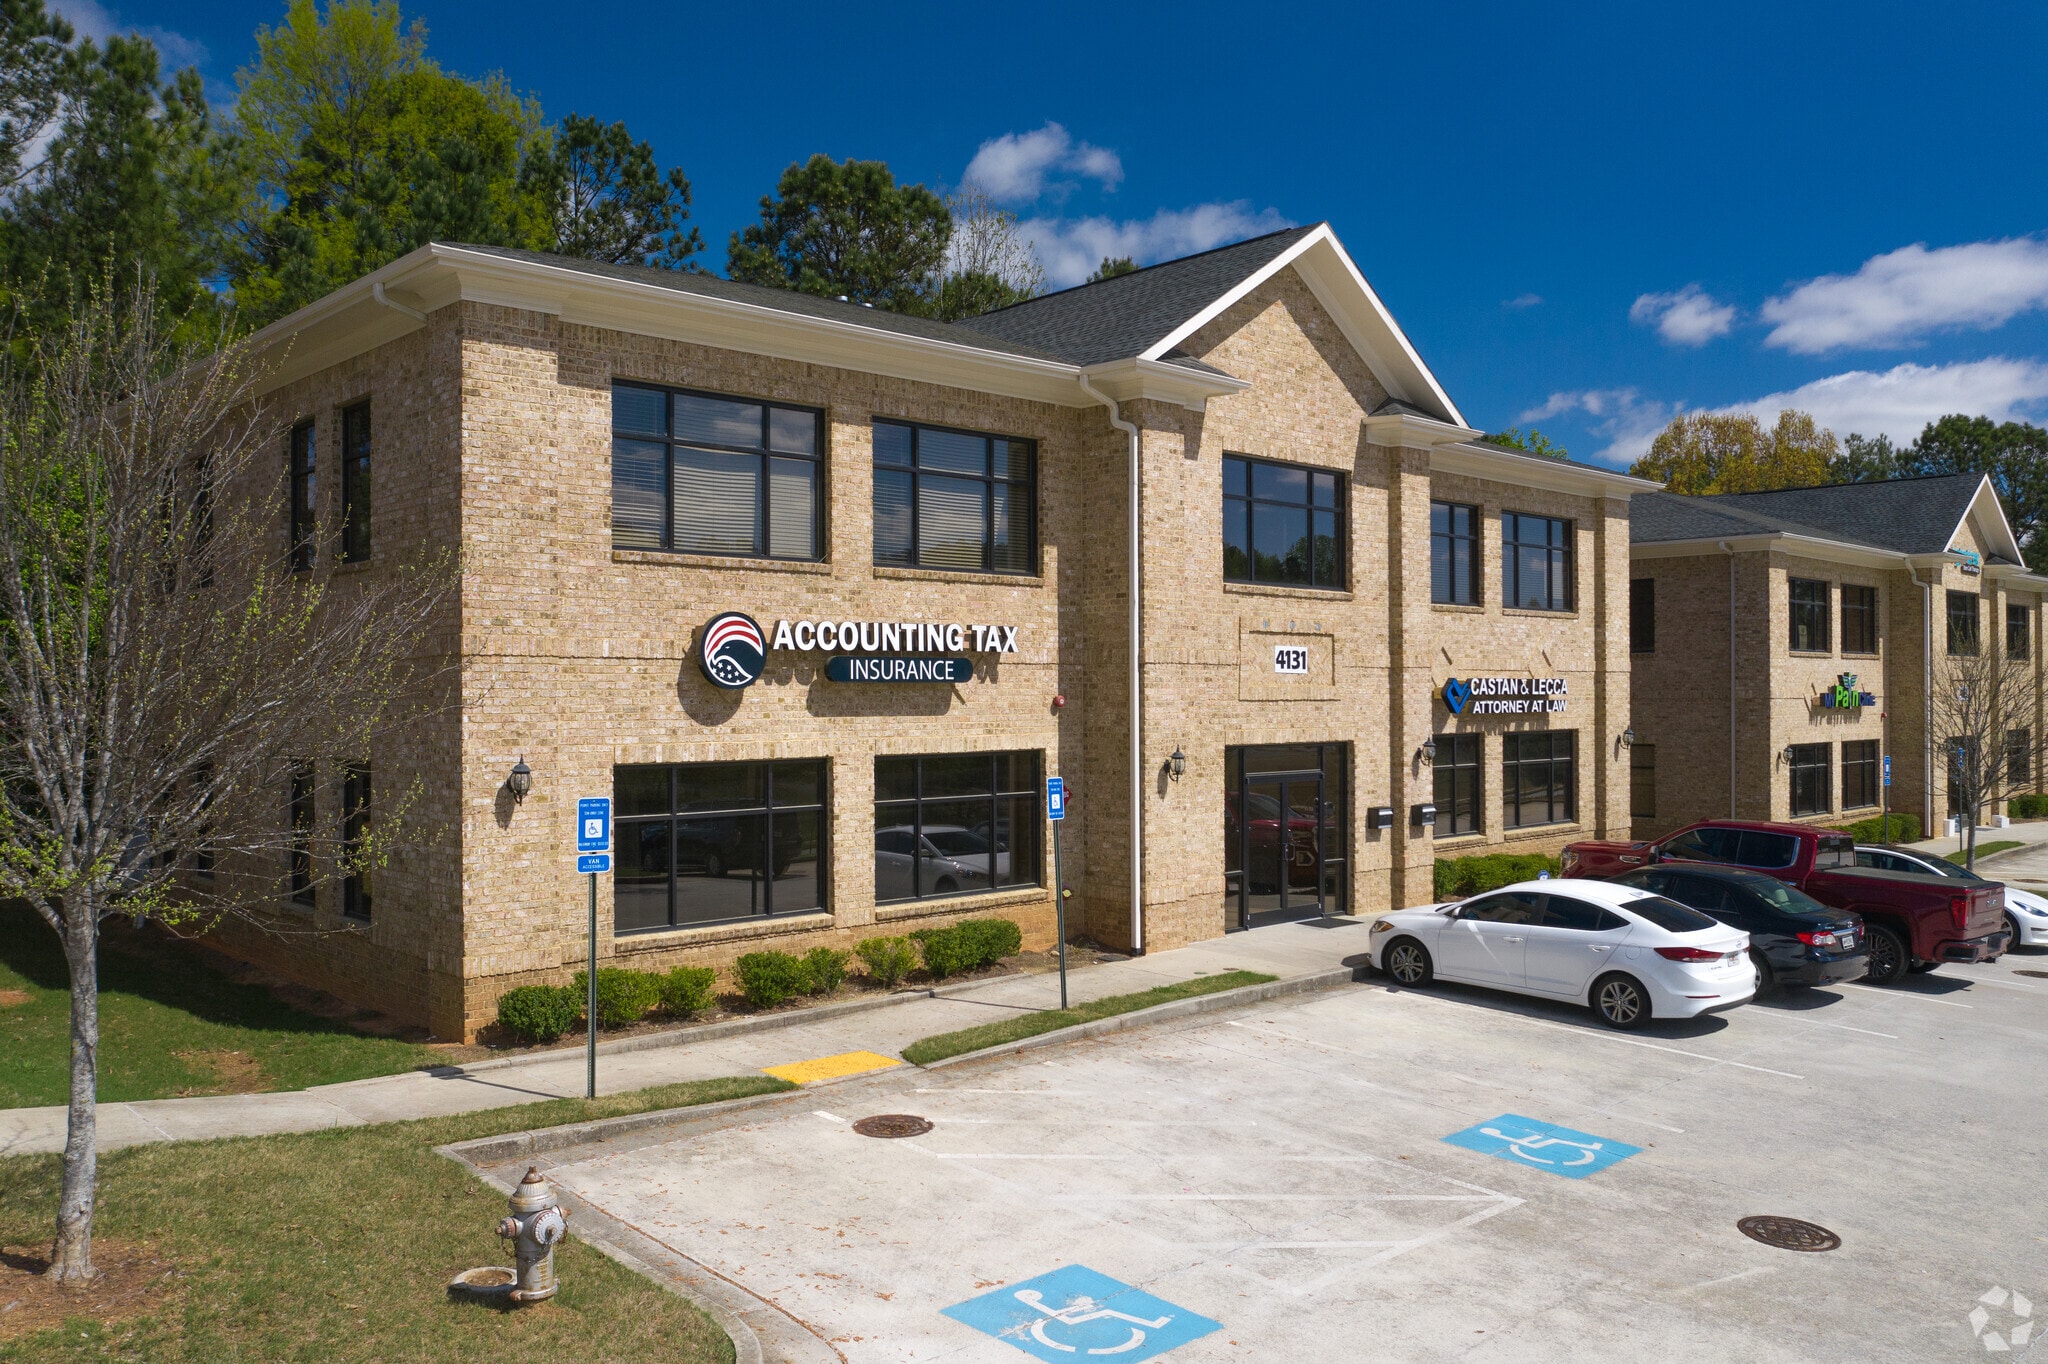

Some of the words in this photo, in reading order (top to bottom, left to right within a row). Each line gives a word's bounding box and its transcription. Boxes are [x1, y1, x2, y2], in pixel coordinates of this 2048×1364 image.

[772, 620, 963, 652] ACCOUNTING
[971, 624, 1018, 653] TAX
[1276, 650, 1306, 669] 4131
[849, 659, 954, 681] INSURANCE
[1471, 678, 1518, 695] CASTAN
[1520, 679, 1530, 695] &
[1532, 679, 1568, 695] LECCA
[1473, 700, 1530, 714] ATTORNEY
[1531, 700, 1544, 713] AT
[1546, 700, 1567, 712] LAW
